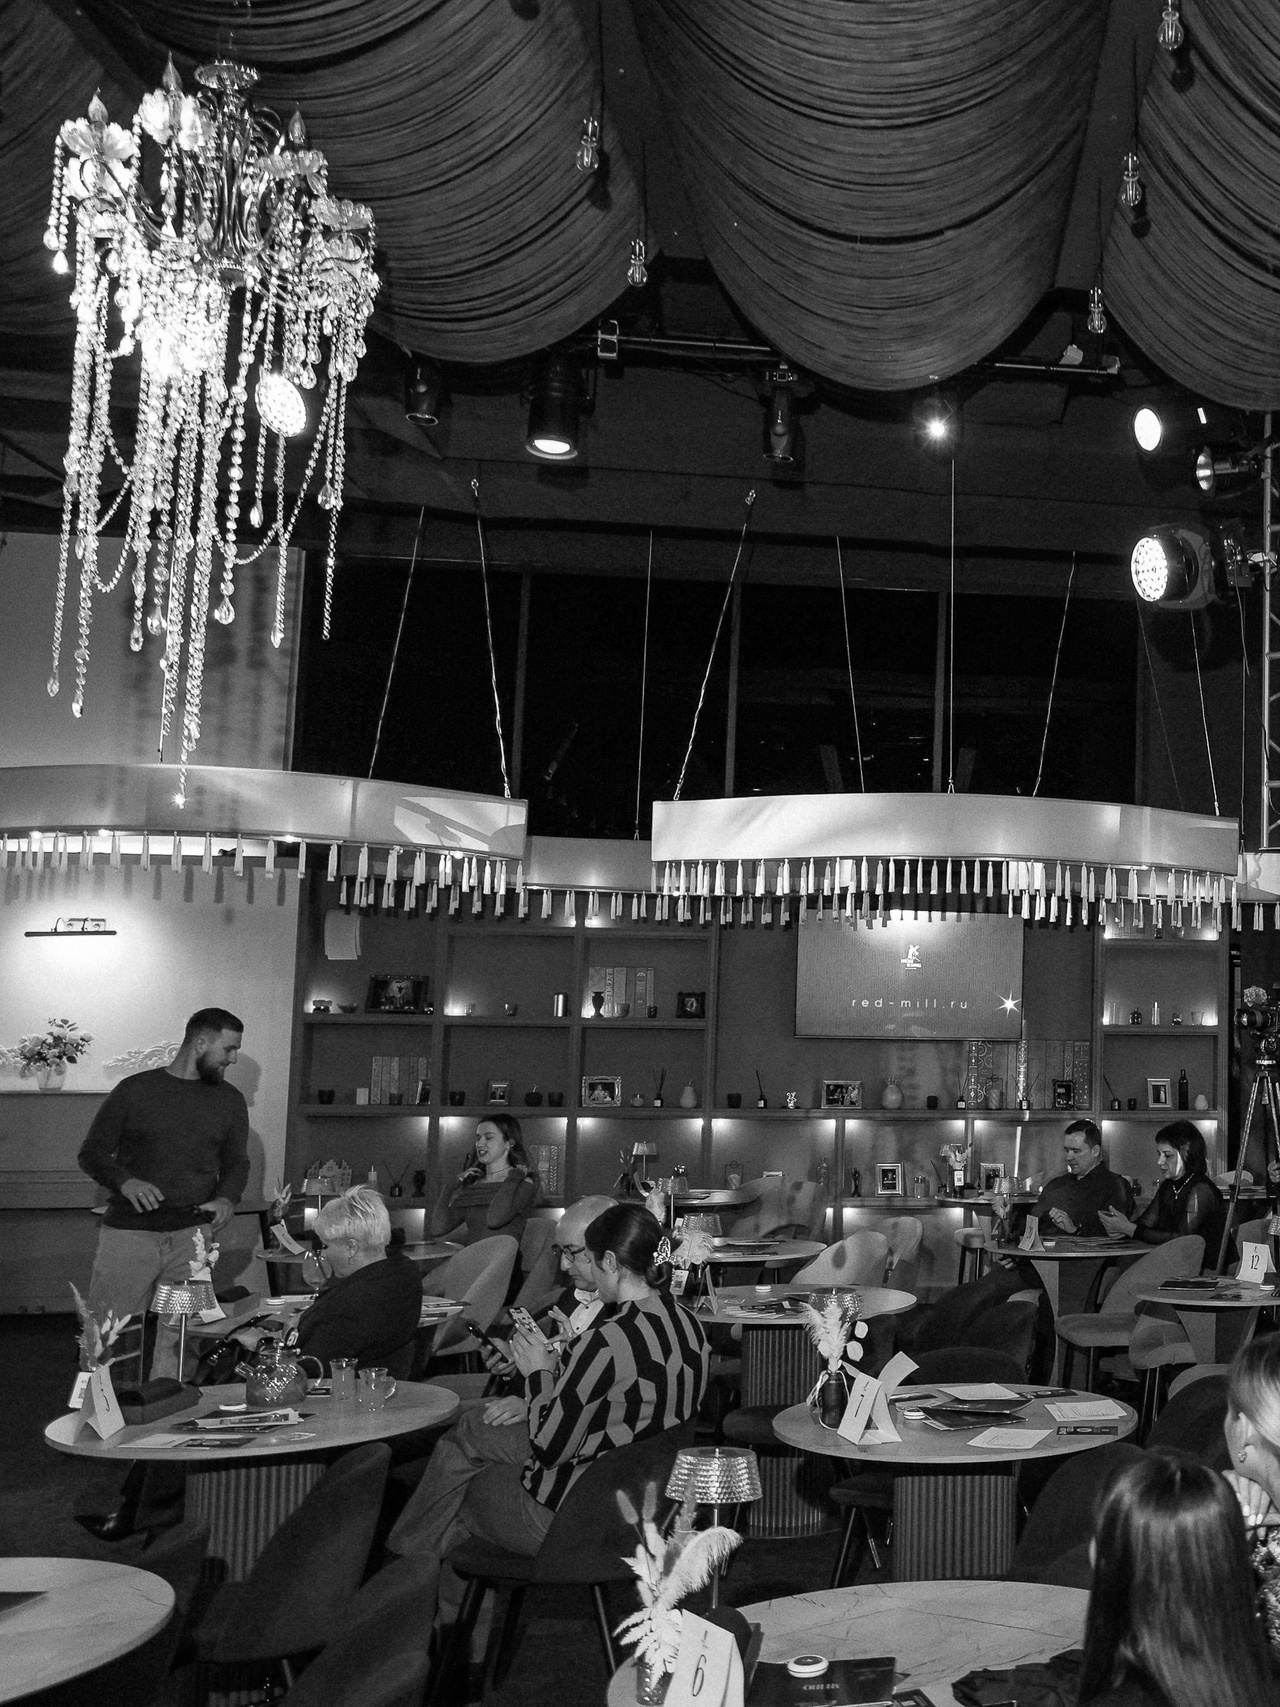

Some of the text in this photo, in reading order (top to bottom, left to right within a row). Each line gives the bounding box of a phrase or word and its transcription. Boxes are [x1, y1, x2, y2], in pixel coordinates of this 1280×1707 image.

[851, 998, 968, 1009] red-mill.ru
[1250, 1254, 1260, 1270] 12
[691, 1653, 707, 1697] 6
